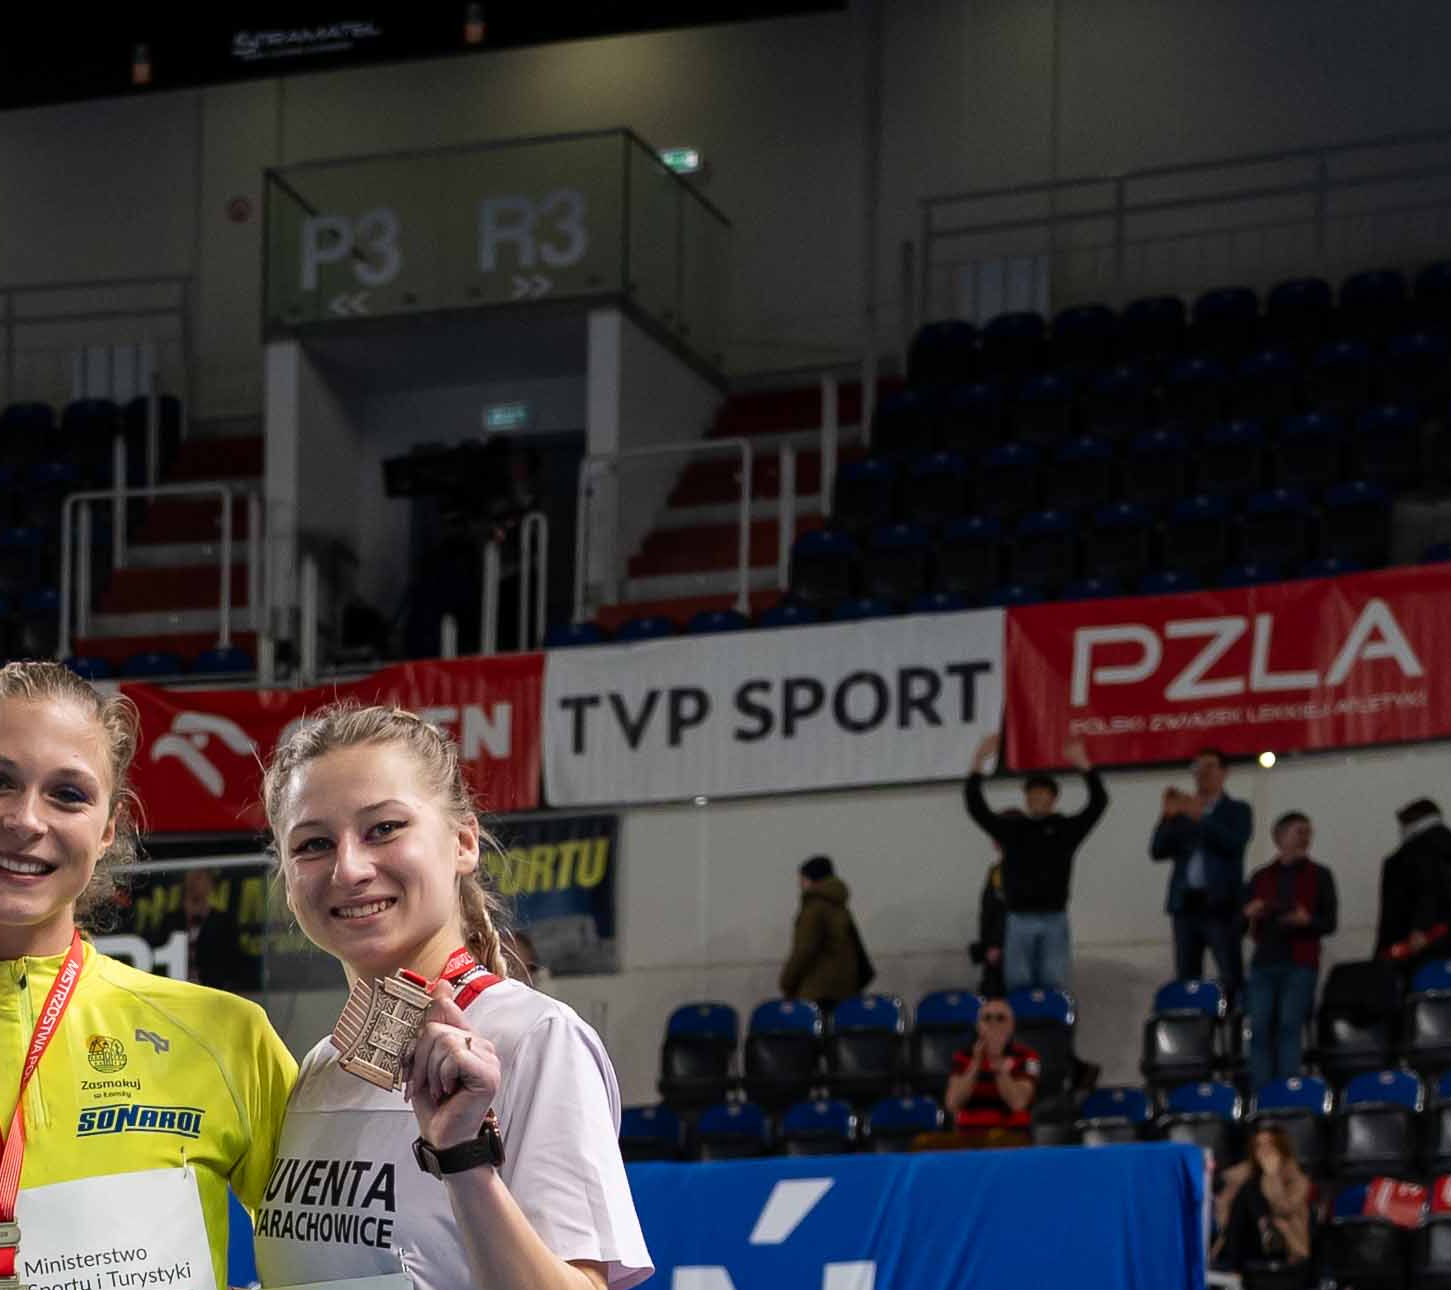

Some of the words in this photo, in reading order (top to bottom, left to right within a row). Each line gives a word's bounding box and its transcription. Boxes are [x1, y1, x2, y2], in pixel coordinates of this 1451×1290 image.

[301, 208, 401, 291] P3
[478, 189, 587, 272] R3
[1070, 599, 1423, 708] PZLA
[560, 688, 708, 755] TVP
[734, 660, 992, 743] SPORT
[81, 1079, 141, 1090] Zasmakuj
[77, 1104, 203, 1135] SONAROL
[264, 1157, 396, 1212] UVENTA
[24, 1247, 148, 1278] Ministerstwo
[97, 1273, 102, 1290] i
[106, 1262, 192, 1290] Turystyki
